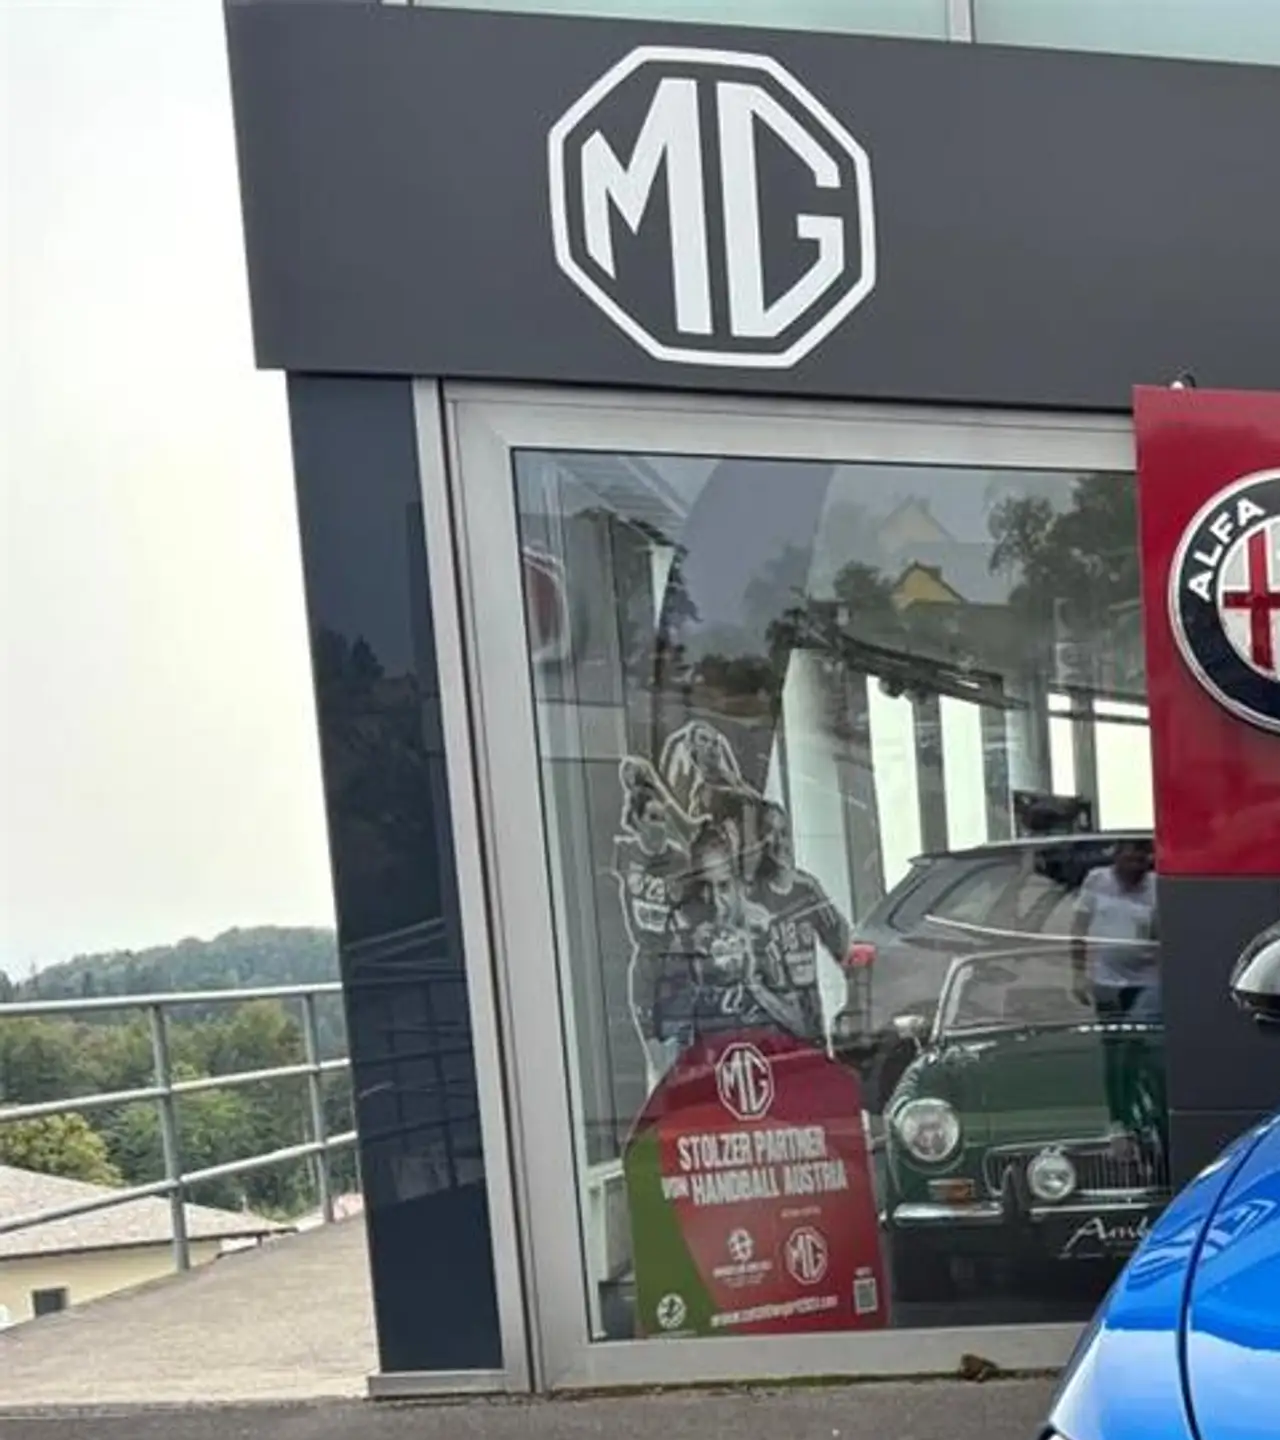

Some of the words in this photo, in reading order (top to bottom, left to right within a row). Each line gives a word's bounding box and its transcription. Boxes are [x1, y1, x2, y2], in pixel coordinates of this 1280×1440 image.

[581, 78, 844, 338] MG
[1188, 499, 1265, 602] ALFA
[721, 1048, 769, 1113] MG
[676, 1132, 752, 1172] STOLZER
[753, 1126, 826, 1163] PARTNER
[690, 1167, 780, 1206] HANDBALL
